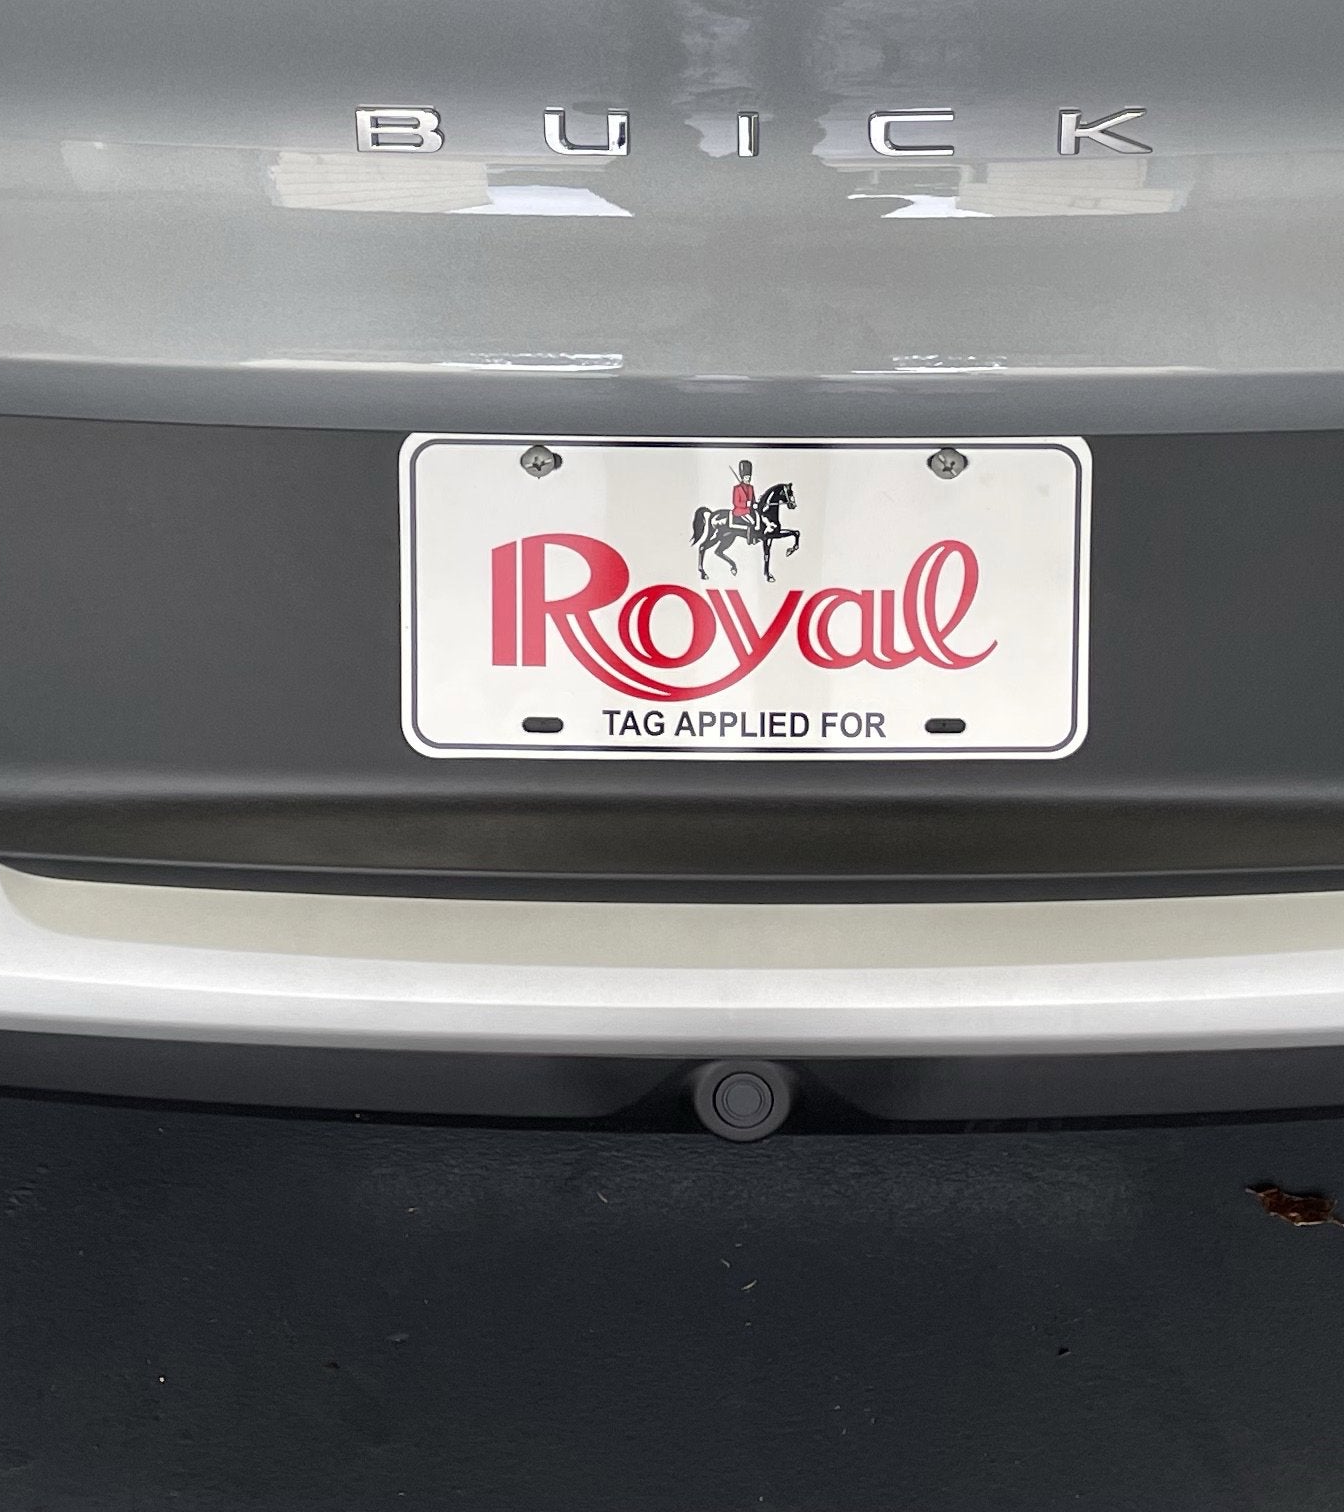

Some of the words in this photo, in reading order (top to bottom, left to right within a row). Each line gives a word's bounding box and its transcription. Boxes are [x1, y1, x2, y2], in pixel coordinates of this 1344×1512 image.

[355, 104, 1152, 157] BUICK
[491, 533, 998, 702] Royal
[602, 710, 665, 736] TAG
[674, 711, 810, 738] APPLIED
[820, 712, 886, 738] FOR
